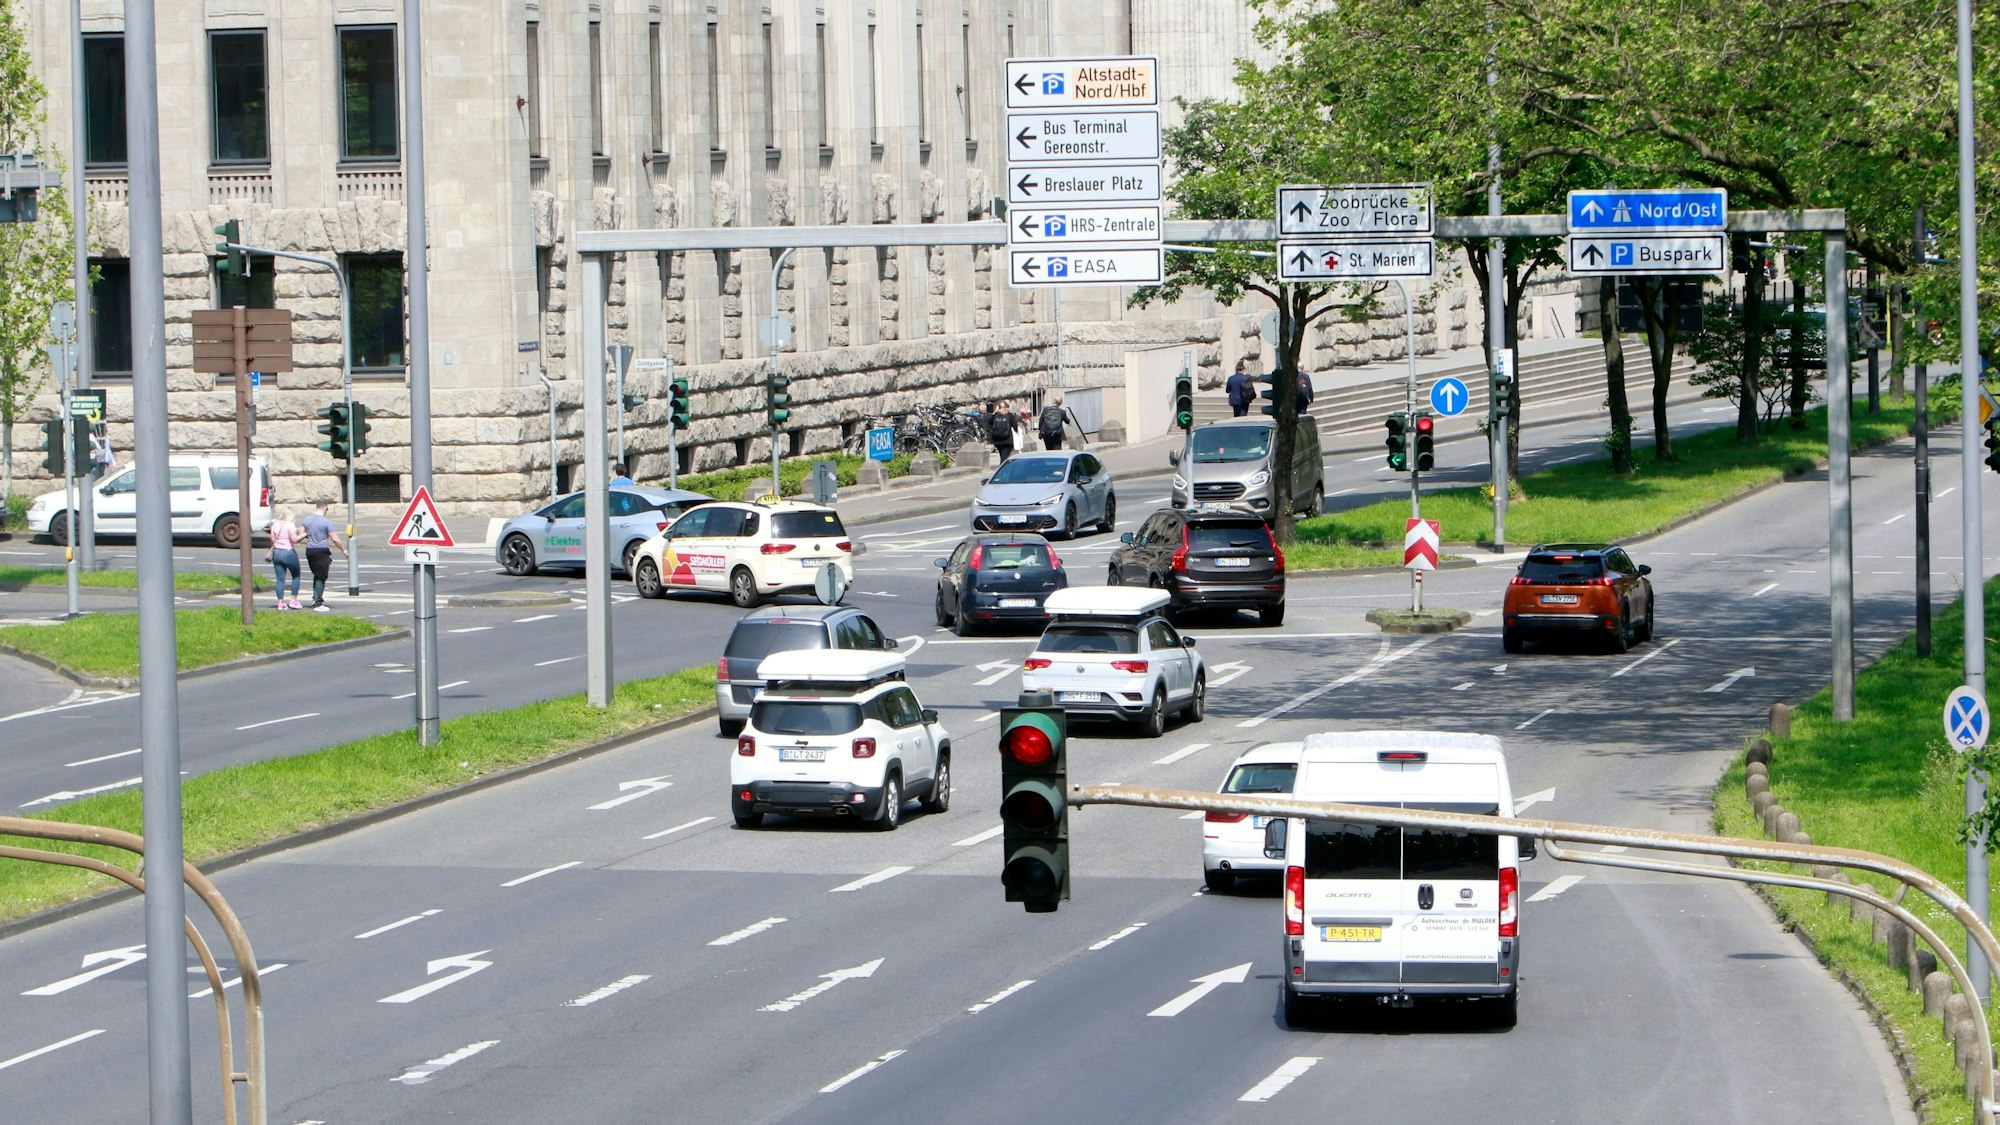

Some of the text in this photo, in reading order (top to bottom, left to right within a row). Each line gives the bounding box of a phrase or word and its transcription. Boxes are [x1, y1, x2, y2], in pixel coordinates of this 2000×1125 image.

[1078, 67, 1144, 82] Altstadt-
[1075, 83, 1147, 98] Nord/Hbf
[1044, 119, 1128, 135] Bus Terminal
[1044, 140, 1109, 154] Gereonstr.
[1045, 176, 1143, 192] Breslauer Platz
[1319, 194, 1409, 209] Zoobrücke
[1639, 202, 1717, 218] Nord/Ost
[1071, 217, 1156, 233] HRS-Zentrale
[1319, 212, 1350, 227] Zoo
[1374, 211, 1418, 226] Flora
[1350, 252, 1415, 268] St. Marien
[1640, 246, 1712, 264] Buspark
[1074, 259, 1117, 274] EASA
[636, 360, 665, 368] Goldgasse
[876, 431, 892, 450] EASA
[550, 535, 581, 546] Elektro
[805, 751, 824, 759] 2437
